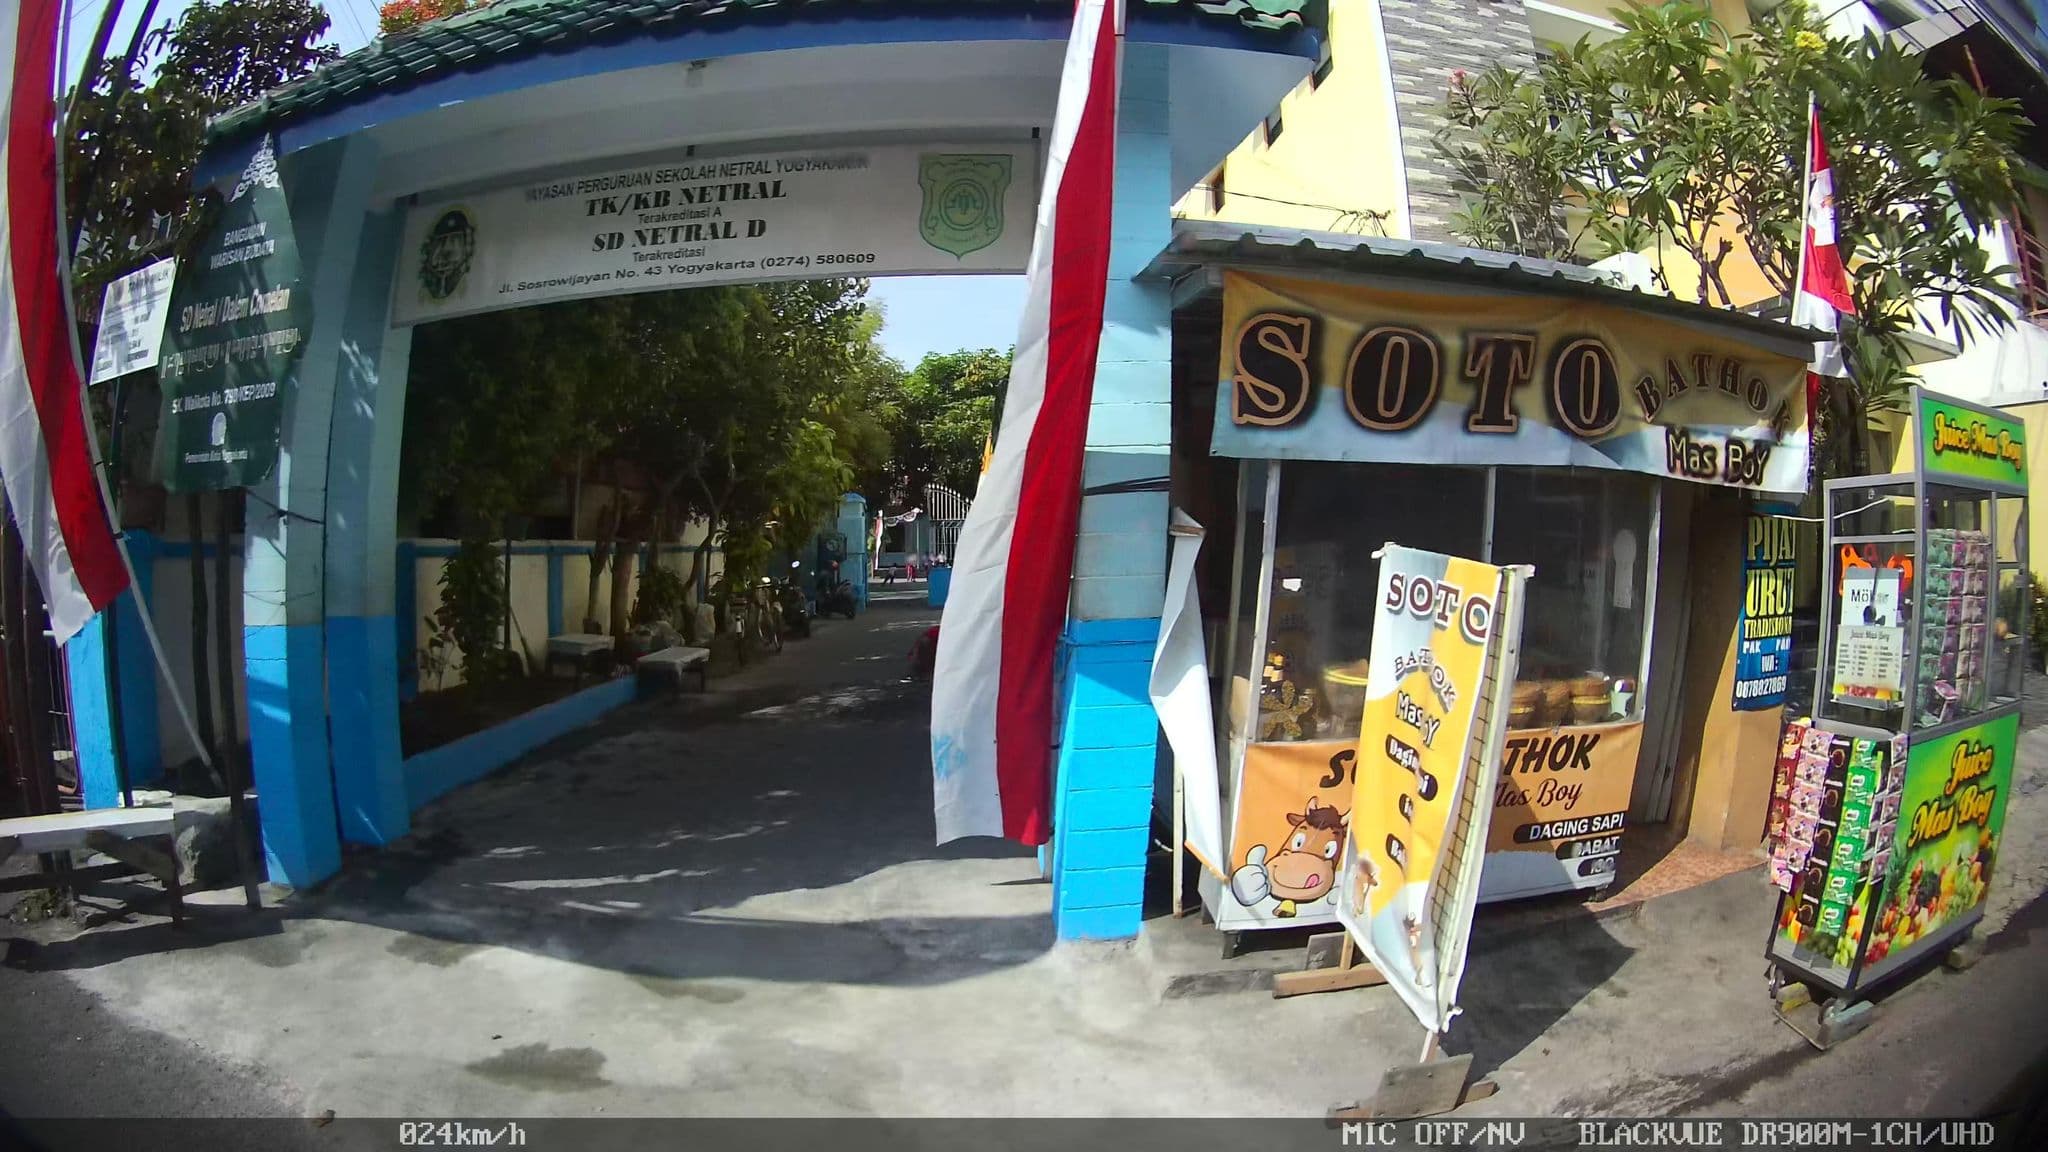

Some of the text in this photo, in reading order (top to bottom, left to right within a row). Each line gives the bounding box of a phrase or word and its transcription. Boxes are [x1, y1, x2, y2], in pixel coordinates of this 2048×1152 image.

[577, 170, 652, 194] PERGURUAN
[655, 163, 716, 184] SEKOLAH
[719, 159, 772, 178] NETRAL
[586, 180, 787, 217] TK/KB NETRAL
[638, 206, 722, 224] Terakreditasi A
[592, 219, 767, 252] SD NETRAL D
[632, 246, 705, 262] Terakreditasi
[499, 253, 876, 294] Jl. Sosrowijayan No. 43 Yogyakarta (0274) 580609
[1233, 312, 1621, 437] SOTO
[1666, 427, 1717, 478] Mas
[1386, 573, 1492, 640] SOTO
[1395, 690, 1424, 730] Mas
[1946, 741, 1993, 794] Juice
[1536, 778, 1583, 811] Boy
[1529, 812, 1625, 841] DAGING SAPI
[1907, 803, 1956, 850] Mas
[1957, 785, 1997, 828] Boy
